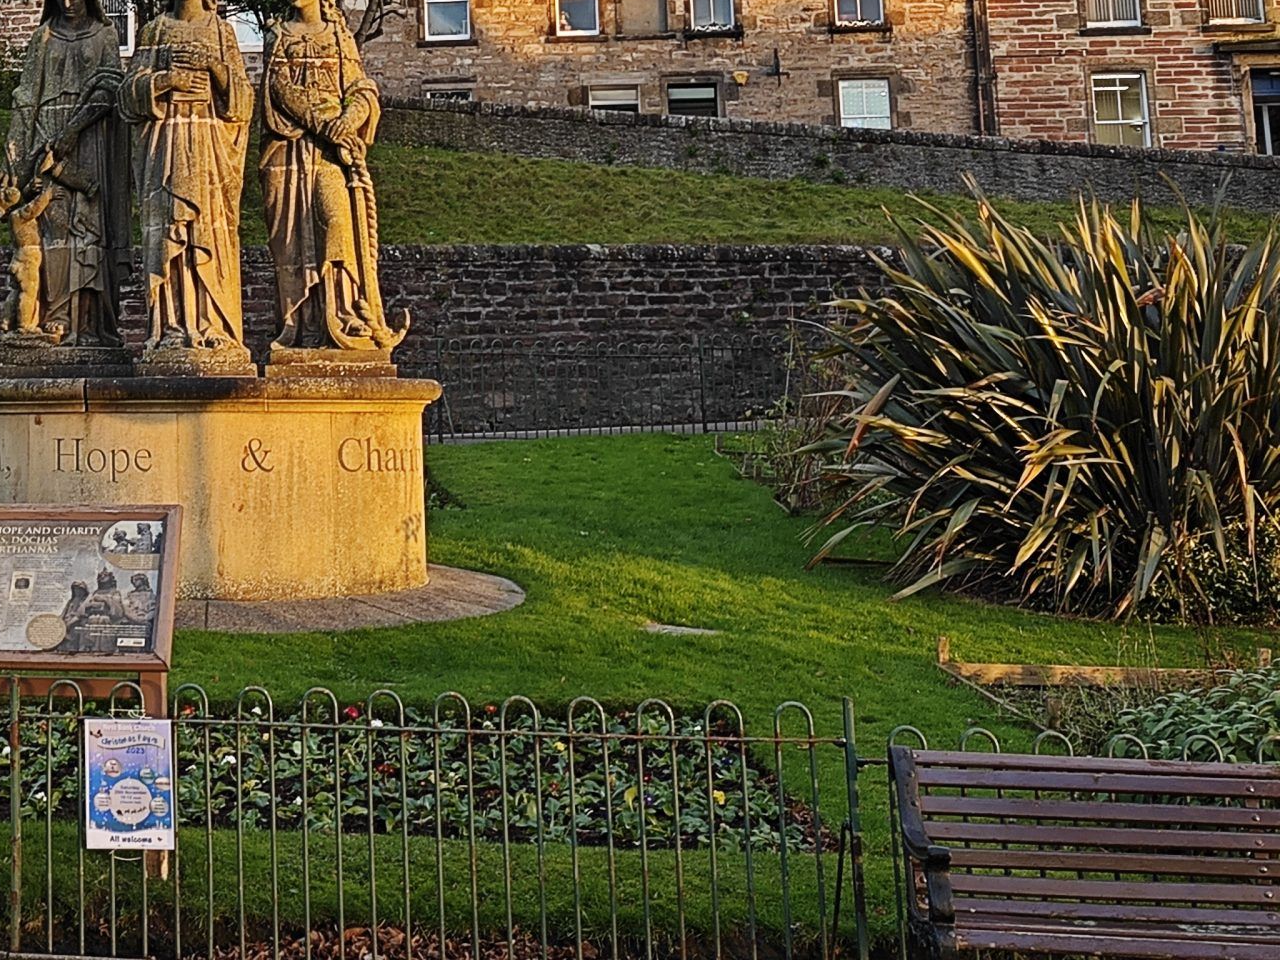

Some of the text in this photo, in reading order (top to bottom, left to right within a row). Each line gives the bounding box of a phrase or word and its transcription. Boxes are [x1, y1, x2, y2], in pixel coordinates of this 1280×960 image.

[52, 438, 153, 483] Hope
[241, 438, 275, 473] &
[25, 526, 51, 535] AND
[53, 526, 103, 535] CHARITY
[110, 835, 152, 843] All welcome
